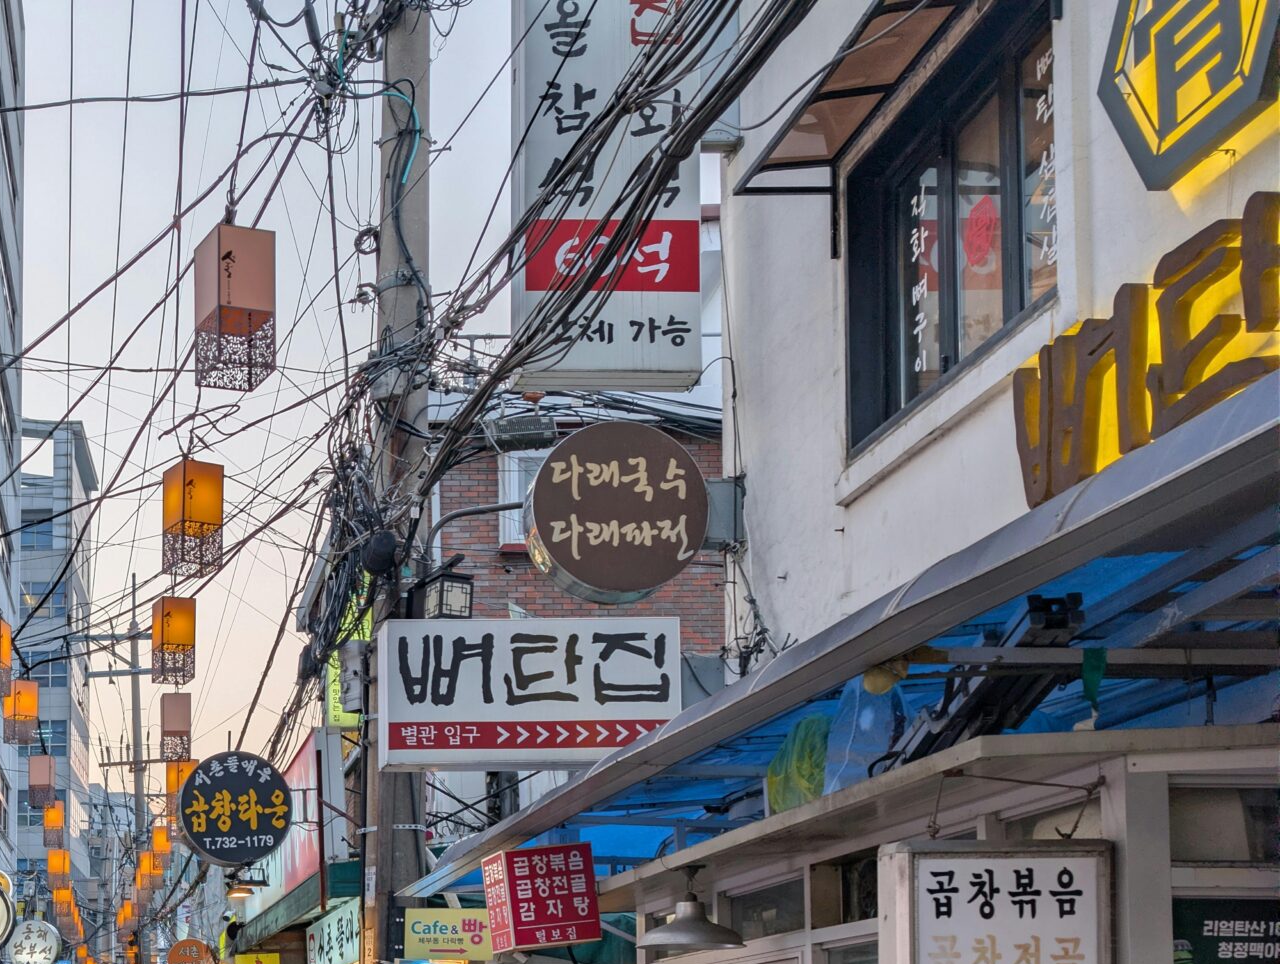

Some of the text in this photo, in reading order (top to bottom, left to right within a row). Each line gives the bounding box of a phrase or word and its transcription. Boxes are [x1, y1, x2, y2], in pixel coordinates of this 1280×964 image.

[630, 317, 692, 347] 가능
[550, 514, 696, 561] 다래파전
[398, 632, 670, 706] 뼈탄집
[401, 725, 481, 747] 별관 입구
[204, 834, 274, 850] T.732-1179
[513, 850, 585, 877] 곱창볶음
[516, 873, 588, 899] 곱창전골
[926, 867, 1084, 920] 곱창볶음
[411, 919, 448, 936] Cafe
[462, 917, 487, 946] 빵
